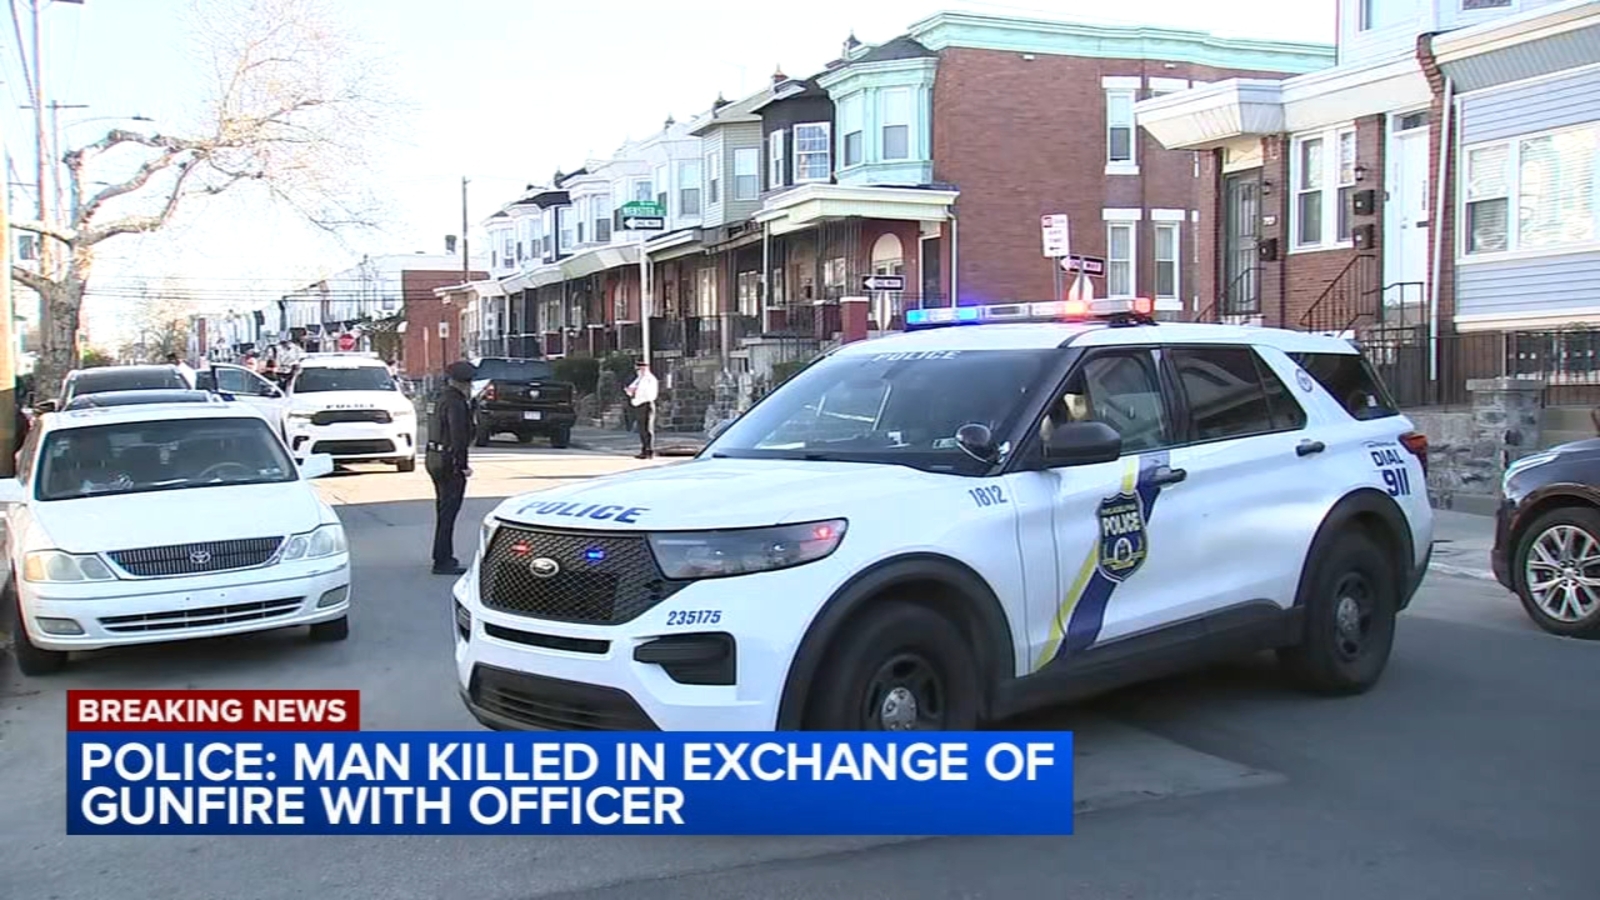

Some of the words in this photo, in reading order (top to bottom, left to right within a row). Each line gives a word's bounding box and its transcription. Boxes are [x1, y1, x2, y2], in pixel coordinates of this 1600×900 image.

[872, 350, 960, 361] POLICE
[1370, 449, 1404, 466] DIAL
[1382, 467, 1411, 496] 911
[968, 485, 1007, 507] 1812
[516, 501, 651, 524] POLICE
[1102, 512, 1142, 537] POLICE
[666, 610, 722, 626] 235175
